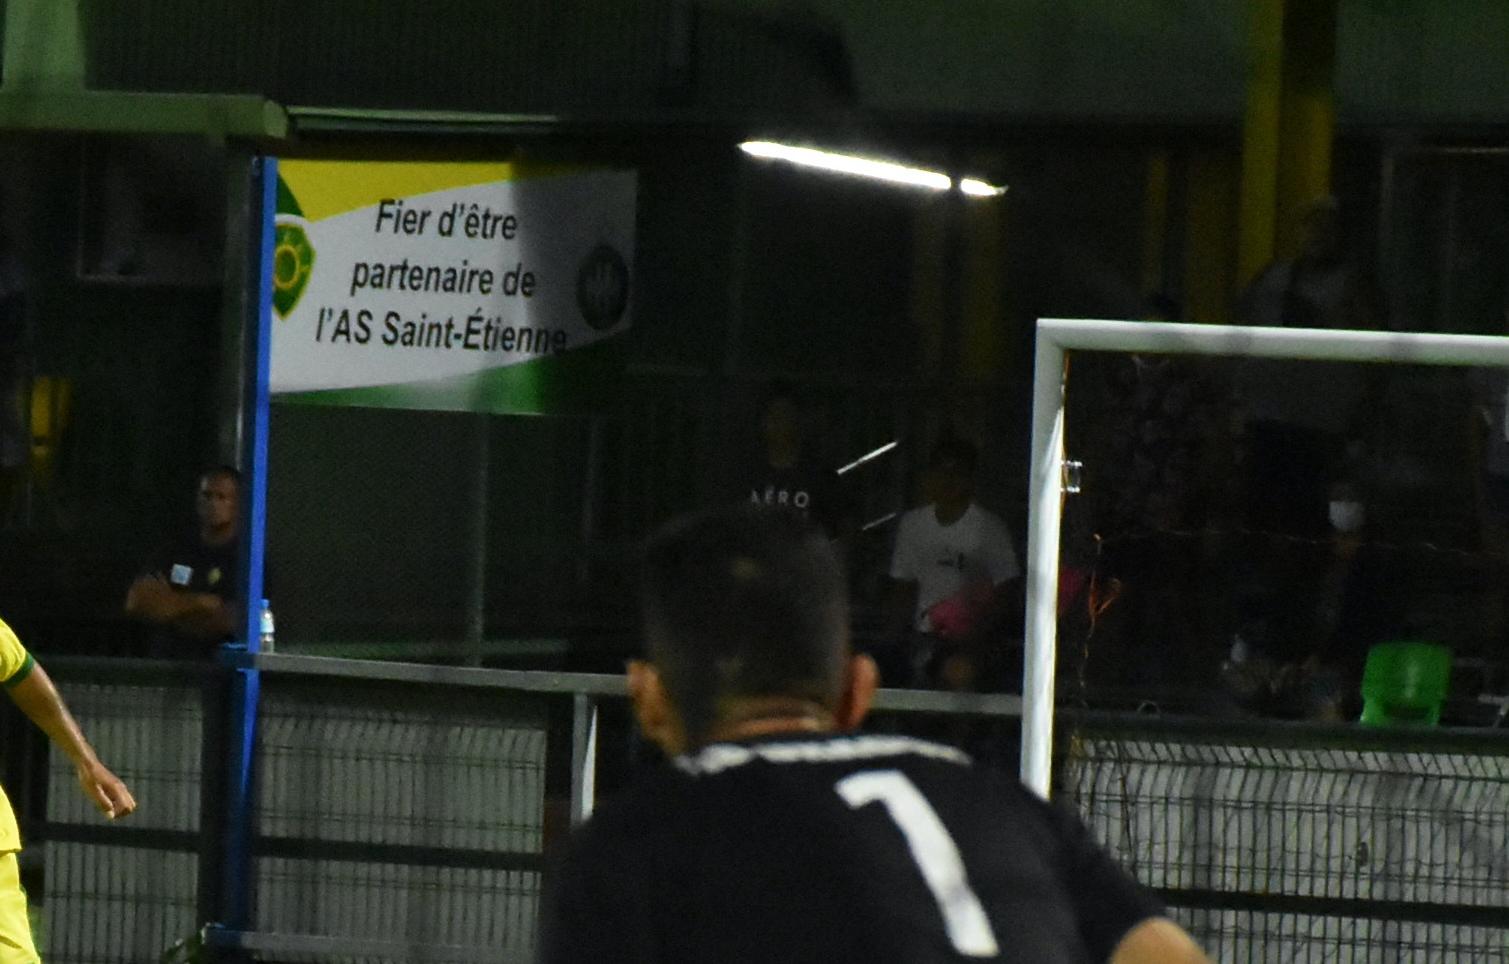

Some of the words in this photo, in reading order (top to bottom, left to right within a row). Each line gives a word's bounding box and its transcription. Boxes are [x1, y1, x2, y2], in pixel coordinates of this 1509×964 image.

[376, 198, 431, 236] Fier
[438, 202, 518, 241] d'être
[351, 258, 494, 297] partenaire
[502, 262, 536, 299] de
[315, 306, 373, 345] l'AS
[382, 306, 568, 356] Saint-Étienne
[834, 768, 1001, 958] 1
